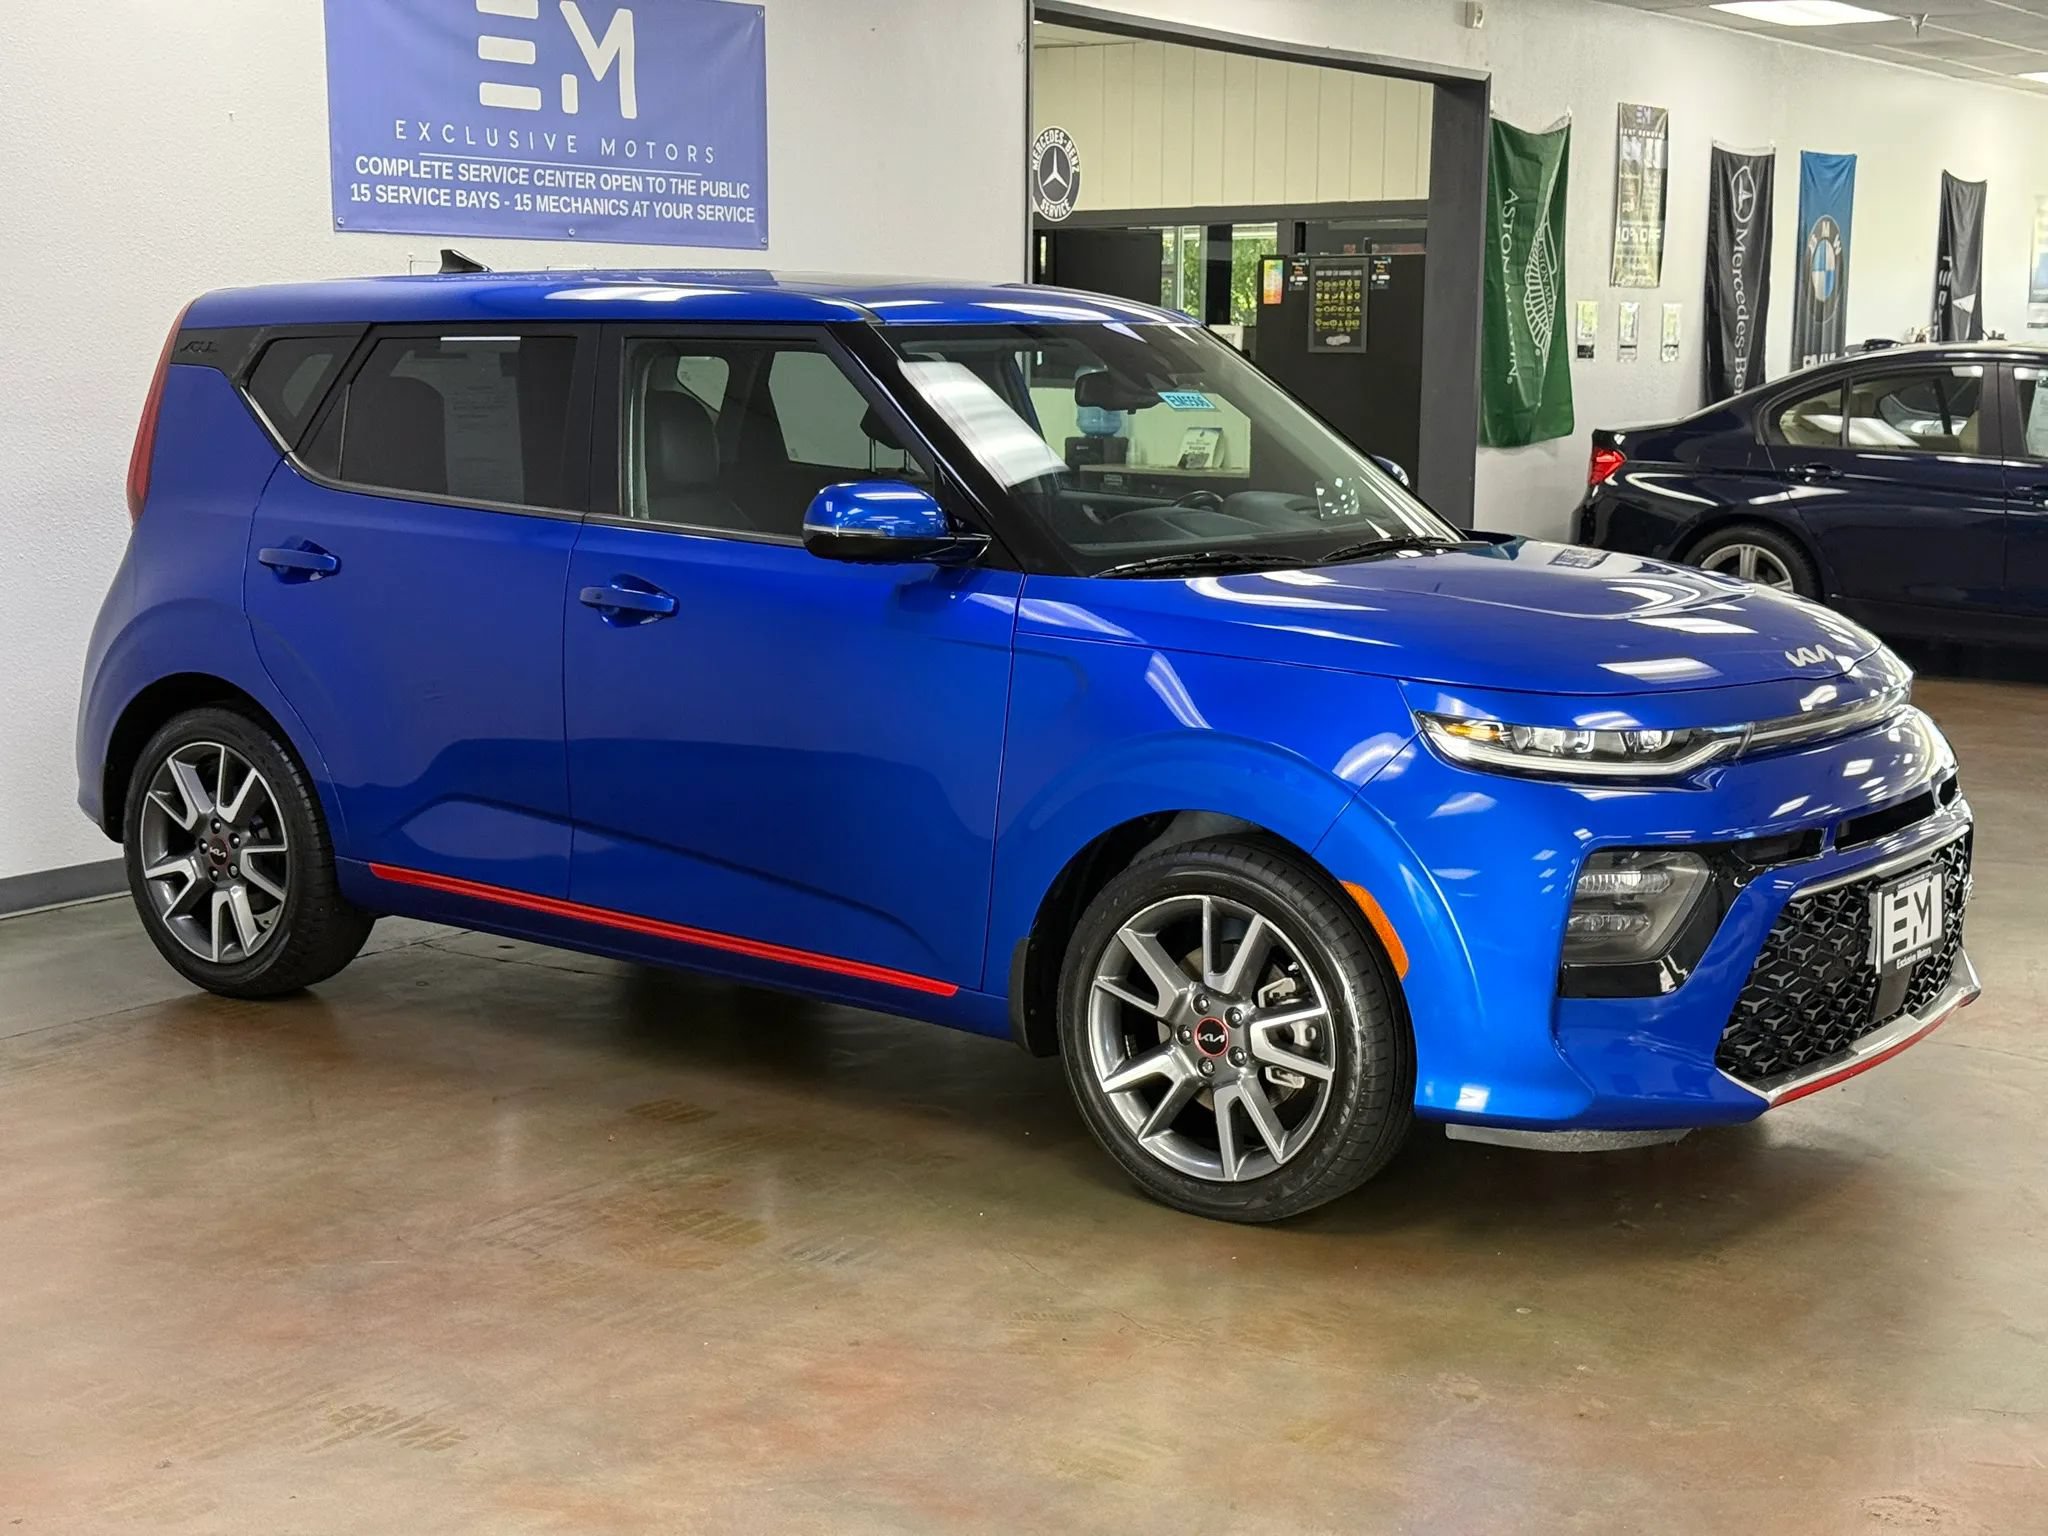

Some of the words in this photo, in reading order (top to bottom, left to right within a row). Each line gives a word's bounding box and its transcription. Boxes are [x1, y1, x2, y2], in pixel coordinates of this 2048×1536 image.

[475, 0, 638, 120] EM
[395, 119, 578, 155] EXCLUSIVE
[600, 137, 715, 165] MOTORS
[355, 155, 454, 181] COMPLETE
[457, 163, 530, 186] SERVICE
[533, 168, 596, 191] CENTER
[599, 173, 643, 193] OPEN
[646, 177, 667, 194] TO
[669, 178, 697, 196] THE
[700, 180, 751, 200] PUBLIC
[350, 183, 371, 202] 15
[375, 184, 451, 207] SERVICE
[455, 189, 500, 210] BAYS
[514, 193, 533, 212] 15
[536, 195, 629, 217] MECHANICS
[631, 201, 651, 218] AT
[653, 202, 694, 220] YOUR
[696, 204, 756, 224] SERVICE
[1040, 198, 1071, 218] SERVICE
[1500, 188, 1519, 273] ASTON
[1892, 884, 1932, 955] EM
